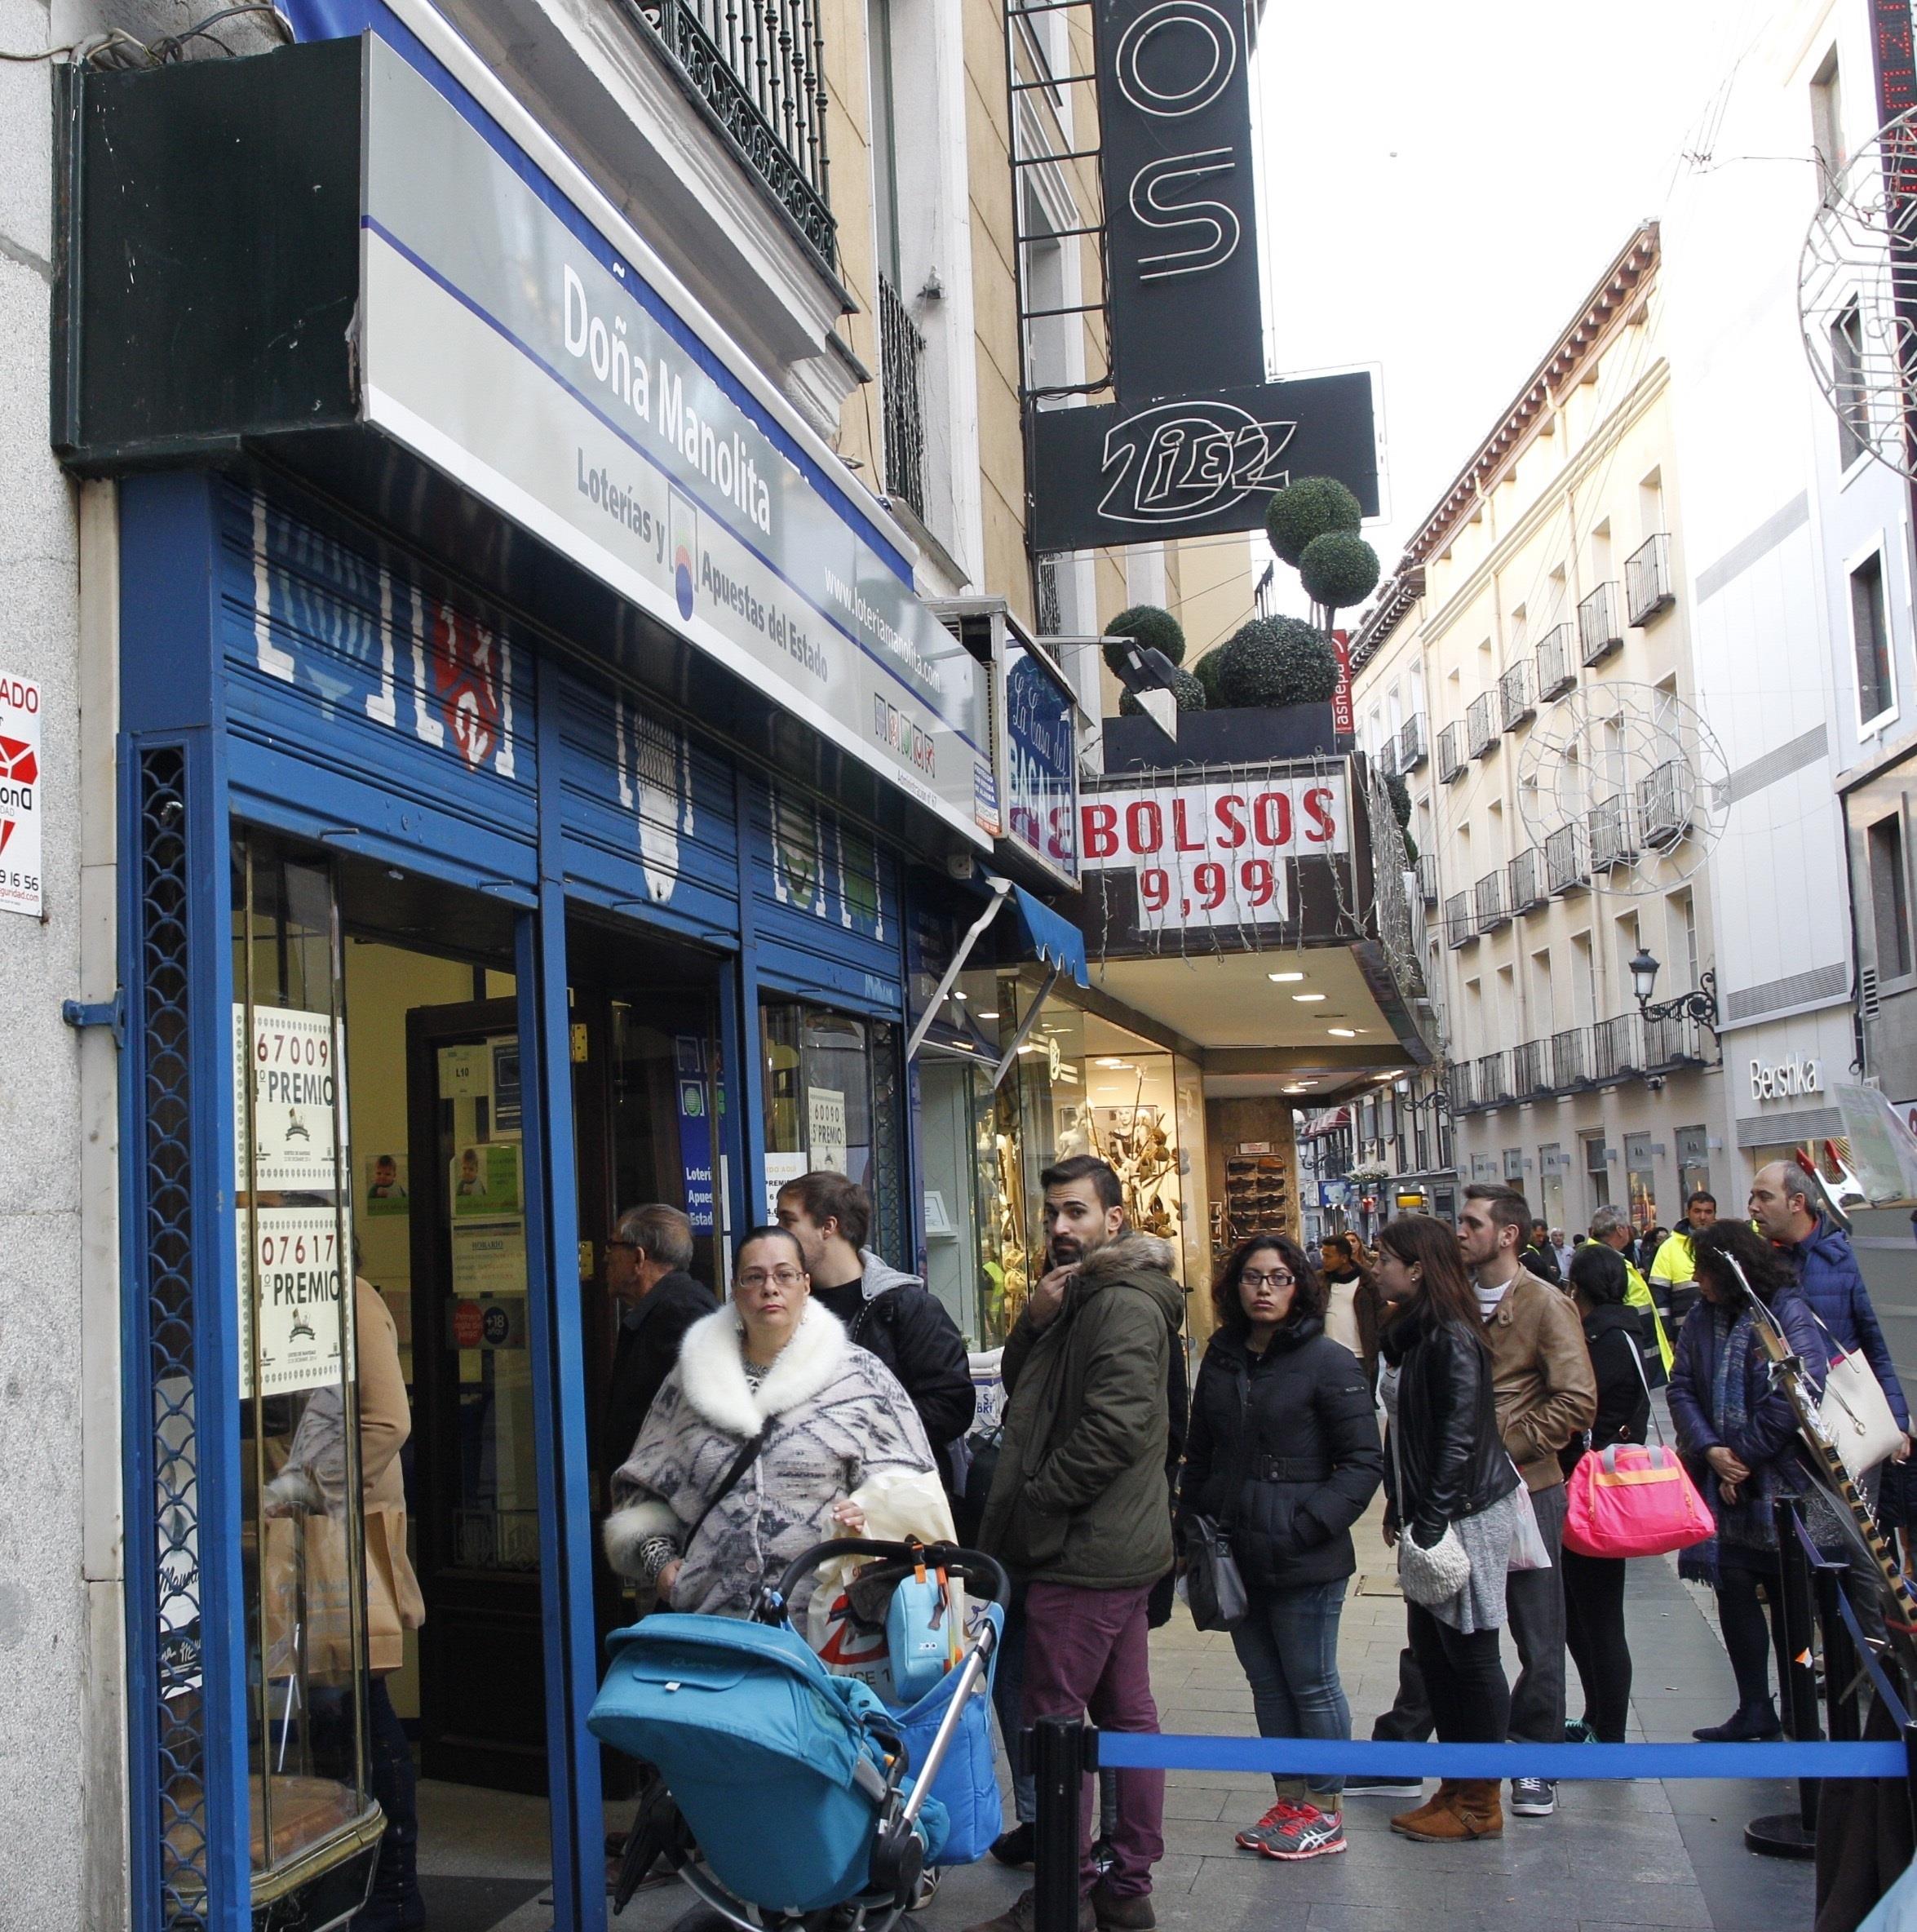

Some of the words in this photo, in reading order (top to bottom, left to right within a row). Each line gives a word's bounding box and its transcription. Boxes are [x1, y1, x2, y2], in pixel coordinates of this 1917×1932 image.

[564, 264, 650, 423] Doña
[658, 359, 771, 535] Manolita
[577, 446, 652, 543] Loterías
[656, 520, 666, 565] y
[702, 550, 765, 633] Apuestas
[768, 604, 787, 650] del
[790, 621, 828, 683] Estado
[825, 567, 941, 693] www.loteriamanolita.com
[1013, 672, 1026, 736] La
[1028, 687, 1051, 760] Casa
[1081, 787, 1336, 859] BOLSOS
[24, 875, 39, 891] 56
[1140, 859, 1275, 919] 9,99
[257, 1033, 328, 1067] 67009
[268, 1070, 334, 1107] PREMIO
[1750, 1052, 1817, 1101] Bershka
[814, 1103, 839, 1123] 60090
[818, 1124, 843, 1144] PREMIO
[262, 1234, 334, 1265] 07617
[274, 1270, 340, 1306] PREMIO
[486, 1314, 505, 1327] +18
